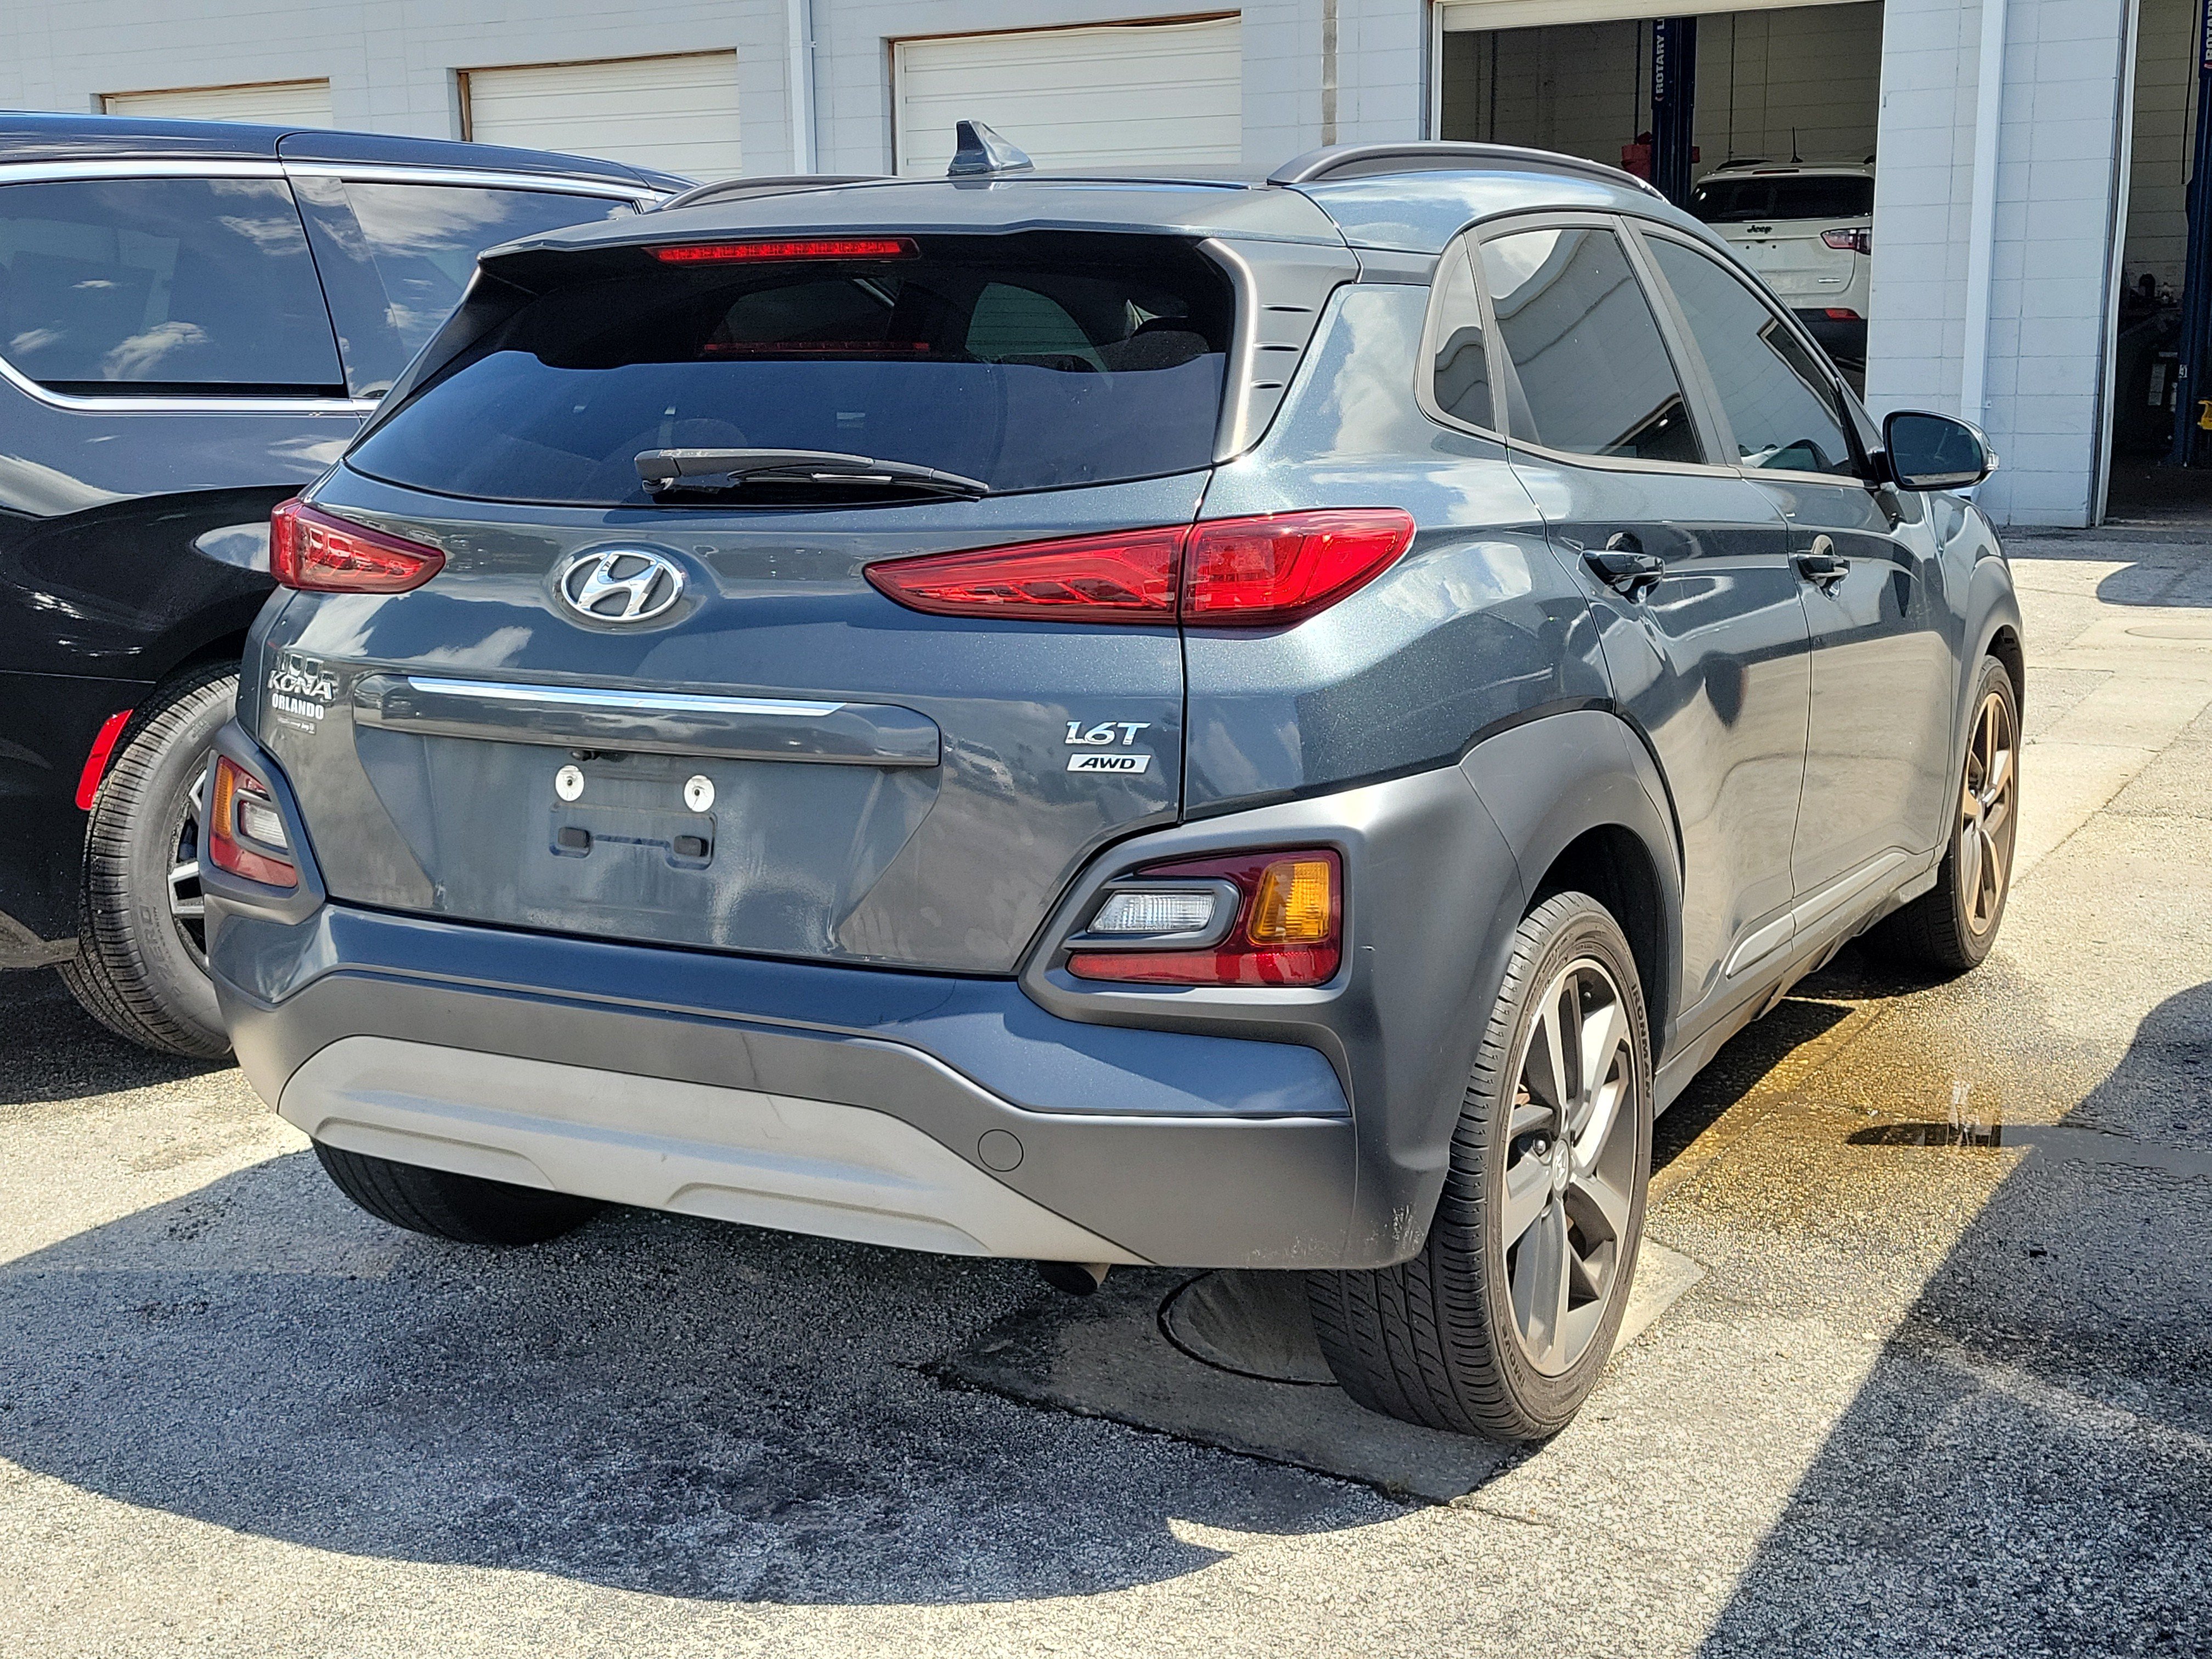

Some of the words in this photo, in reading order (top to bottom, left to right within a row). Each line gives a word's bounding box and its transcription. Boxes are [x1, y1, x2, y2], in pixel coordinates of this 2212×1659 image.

[1656, 35, 1664, 94] ROTARY
[1747, 225, 1773, 234] Jeep
[267, 670, 333, 700] KONA
[272, 693, 324, 720] ORLANDO
[1078, 757, 1136, 769] AWD
[1630, 983, 1651, 1098] IRONMAN
